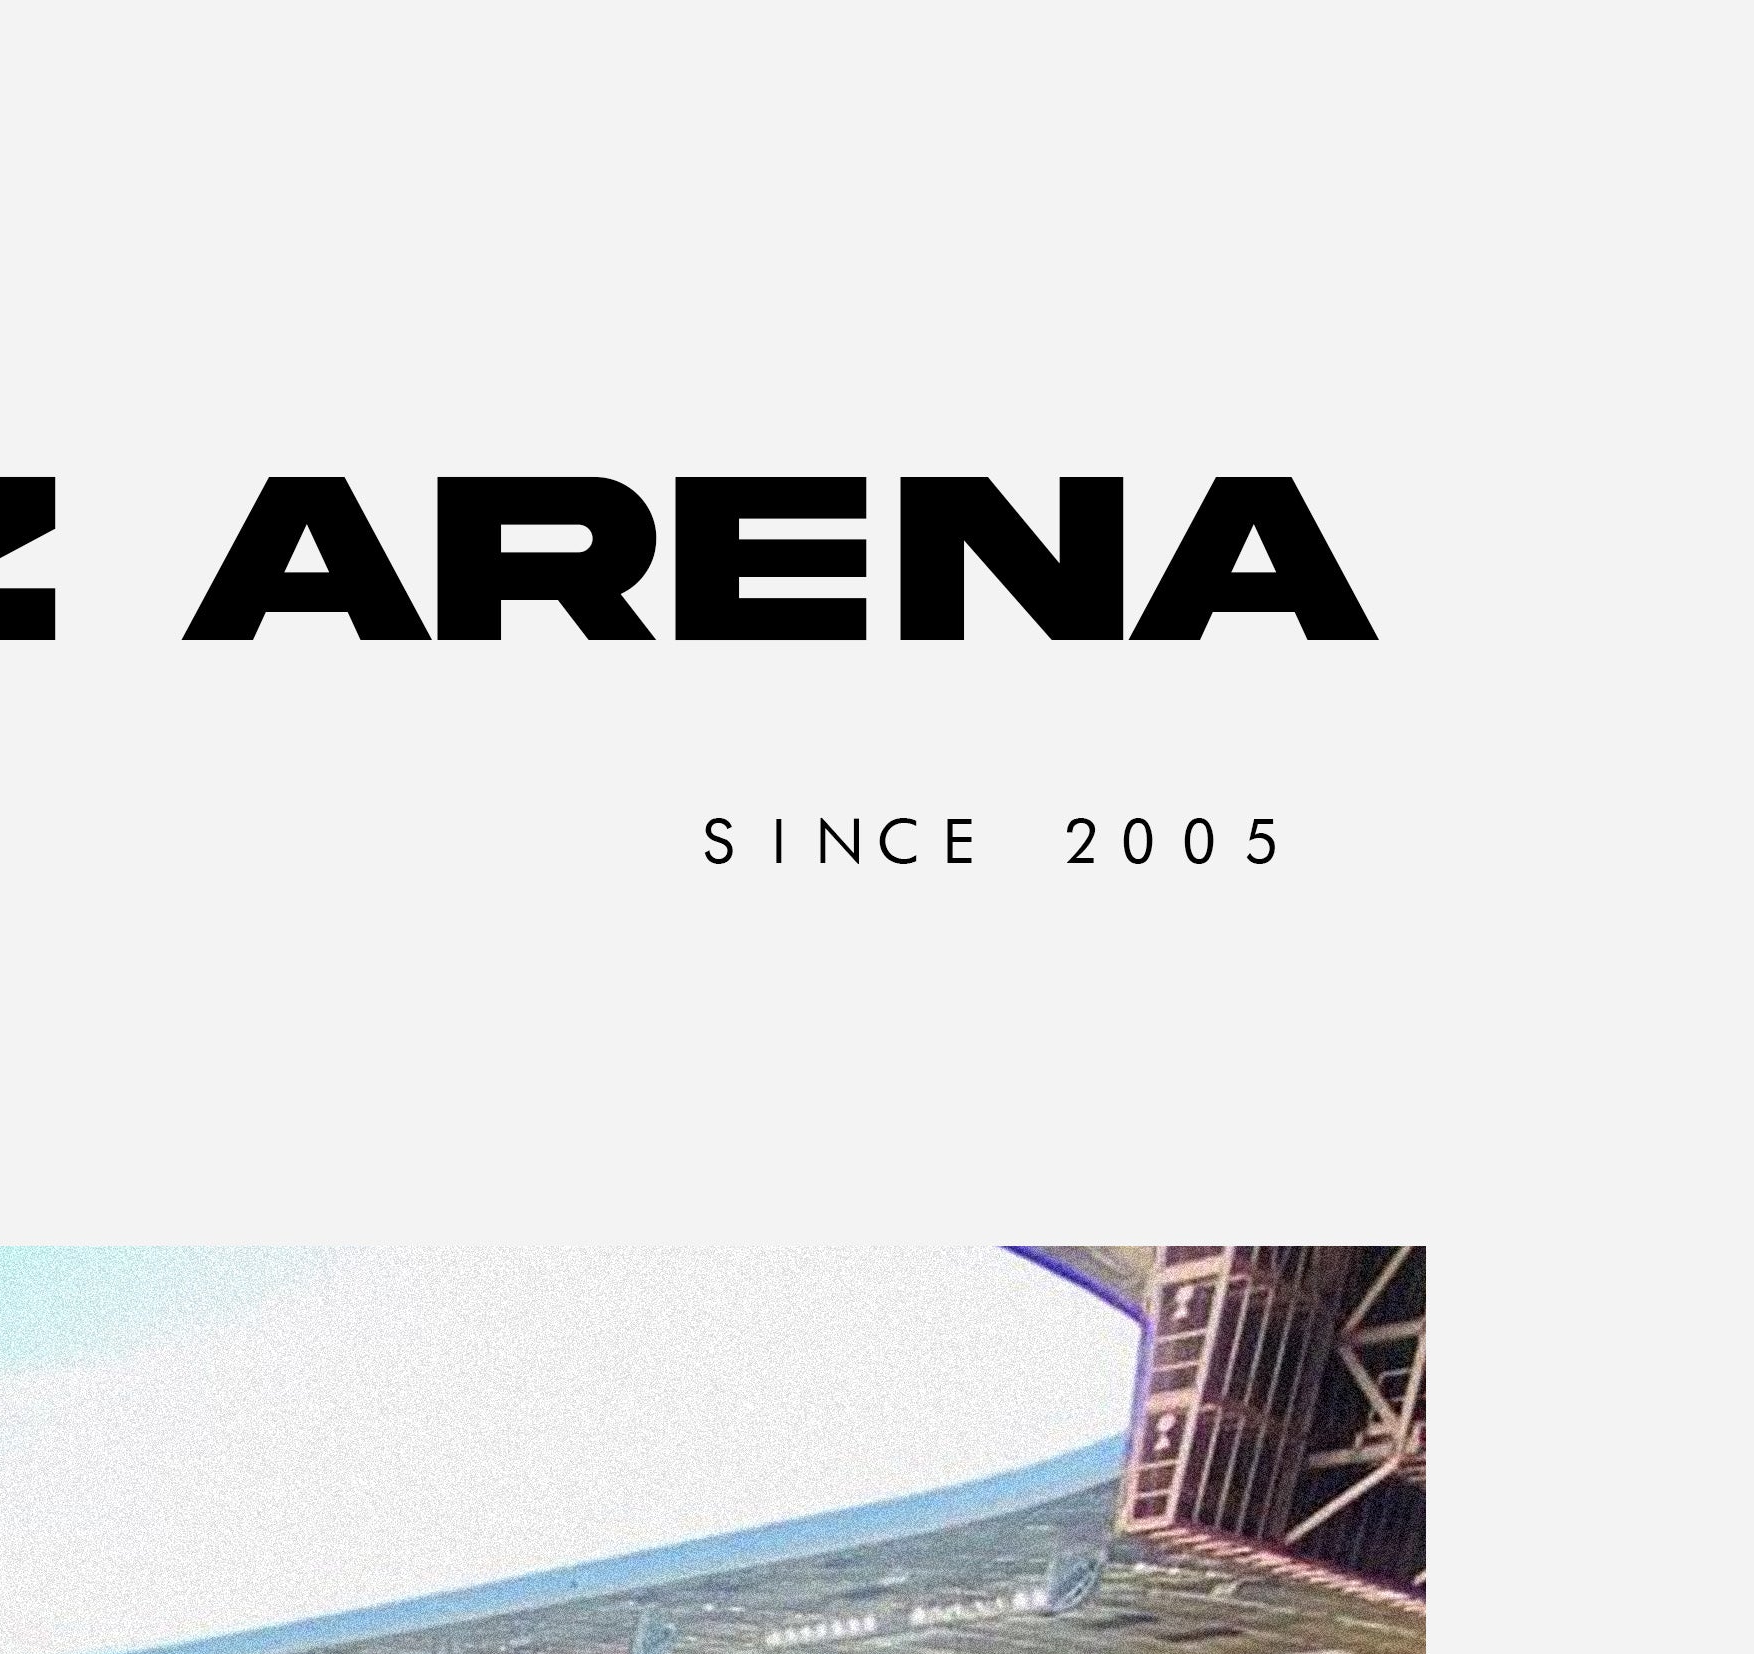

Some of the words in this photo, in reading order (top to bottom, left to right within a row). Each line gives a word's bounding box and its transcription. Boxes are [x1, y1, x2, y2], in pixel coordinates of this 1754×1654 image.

[181, 476, 1380, 641] ARENA
[704, 817, 973, 865] SINCE
[1066, 817, 1276, 865] 2005
